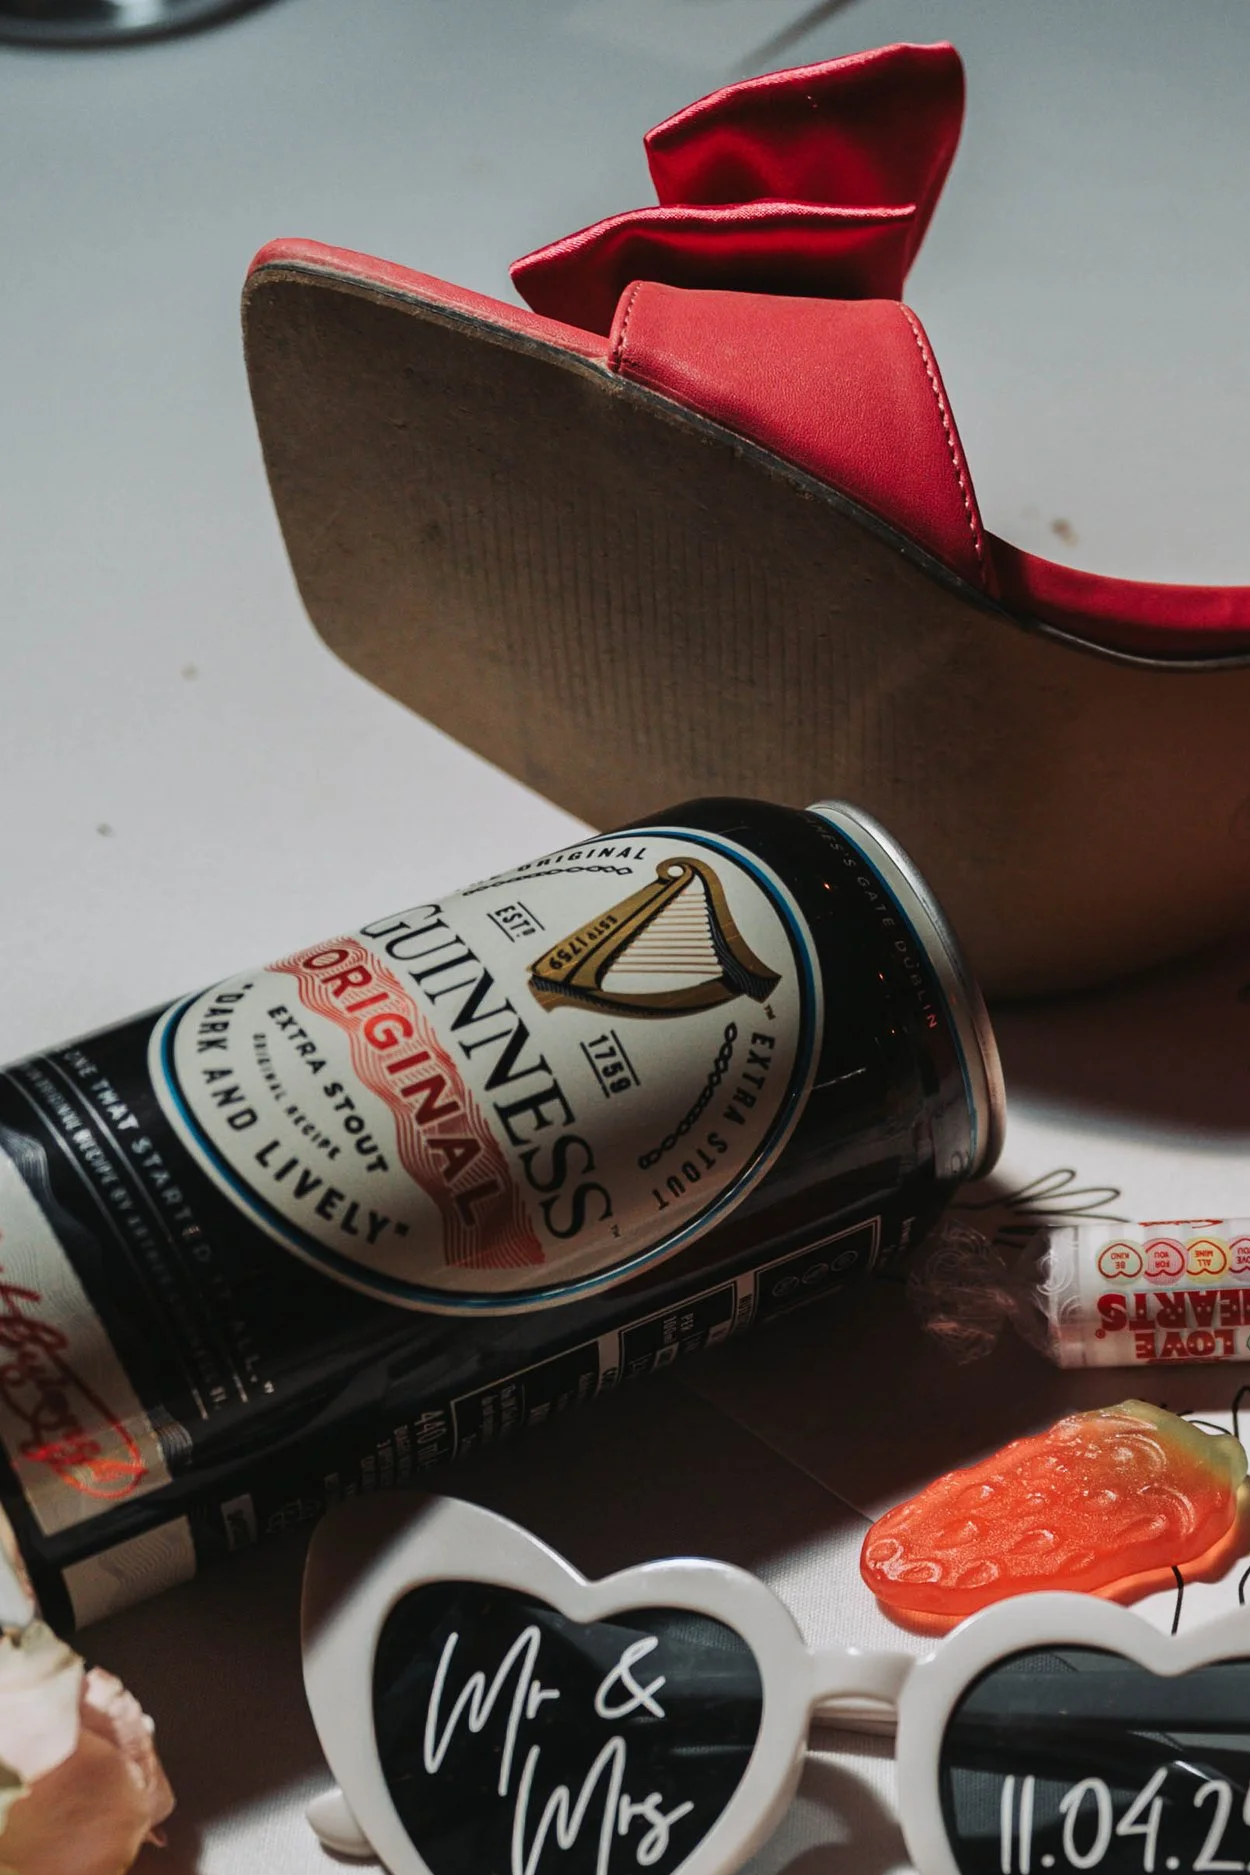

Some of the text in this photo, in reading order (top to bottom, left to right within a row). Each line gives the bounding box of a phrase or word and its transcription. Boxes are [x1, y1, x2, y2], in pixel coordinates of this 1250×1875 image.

[517, 847, 648, 872] ORIGINAL
[548, 935, 589, 970] 1759
[857, 875, 895, 927] GATE
[894, 939, 938, 1029] DUBLIN
[267, 1003, 390, 1174] EXTRA STOUT
[302, 949, 500, 1228] ORIGINAL
[360, 903, 613, 1239] GUINNESS
[588, 1034, 631, 1095] 1759
[91, 1077, 140, 1130] THAT
[202, 1067, 259, 1132] AND
[651, 1031, 776, 1210] EXTRA STOUT
[285, 1105, 342, 1161] RECIPE
[1194, 1249, 1214, 1258] MINE
[1135, 1329, 1236, 1359] LOVE
[422, 1624, 667, 1796] Mr &
